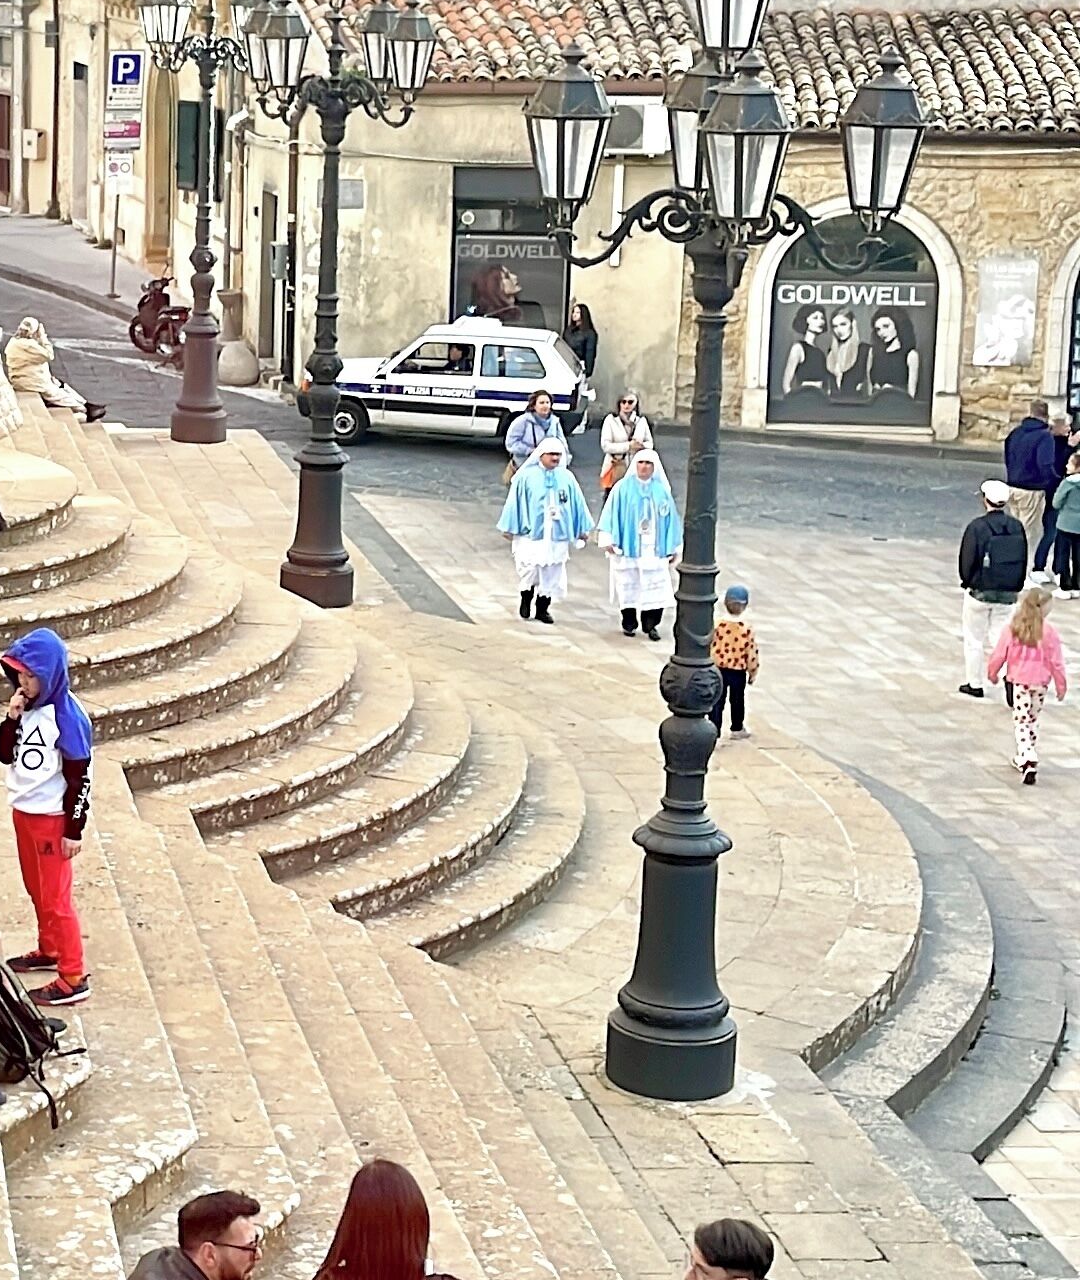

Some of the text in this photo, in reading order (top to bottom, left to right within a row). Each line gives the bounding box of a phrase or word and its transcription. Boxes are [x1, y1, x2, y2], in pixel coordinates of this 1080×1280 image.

[117, 58, 135, 82] P
[458, 243, 563, 259] GOLDWELL
[777, 284, 927, 307] GOLDWELL
